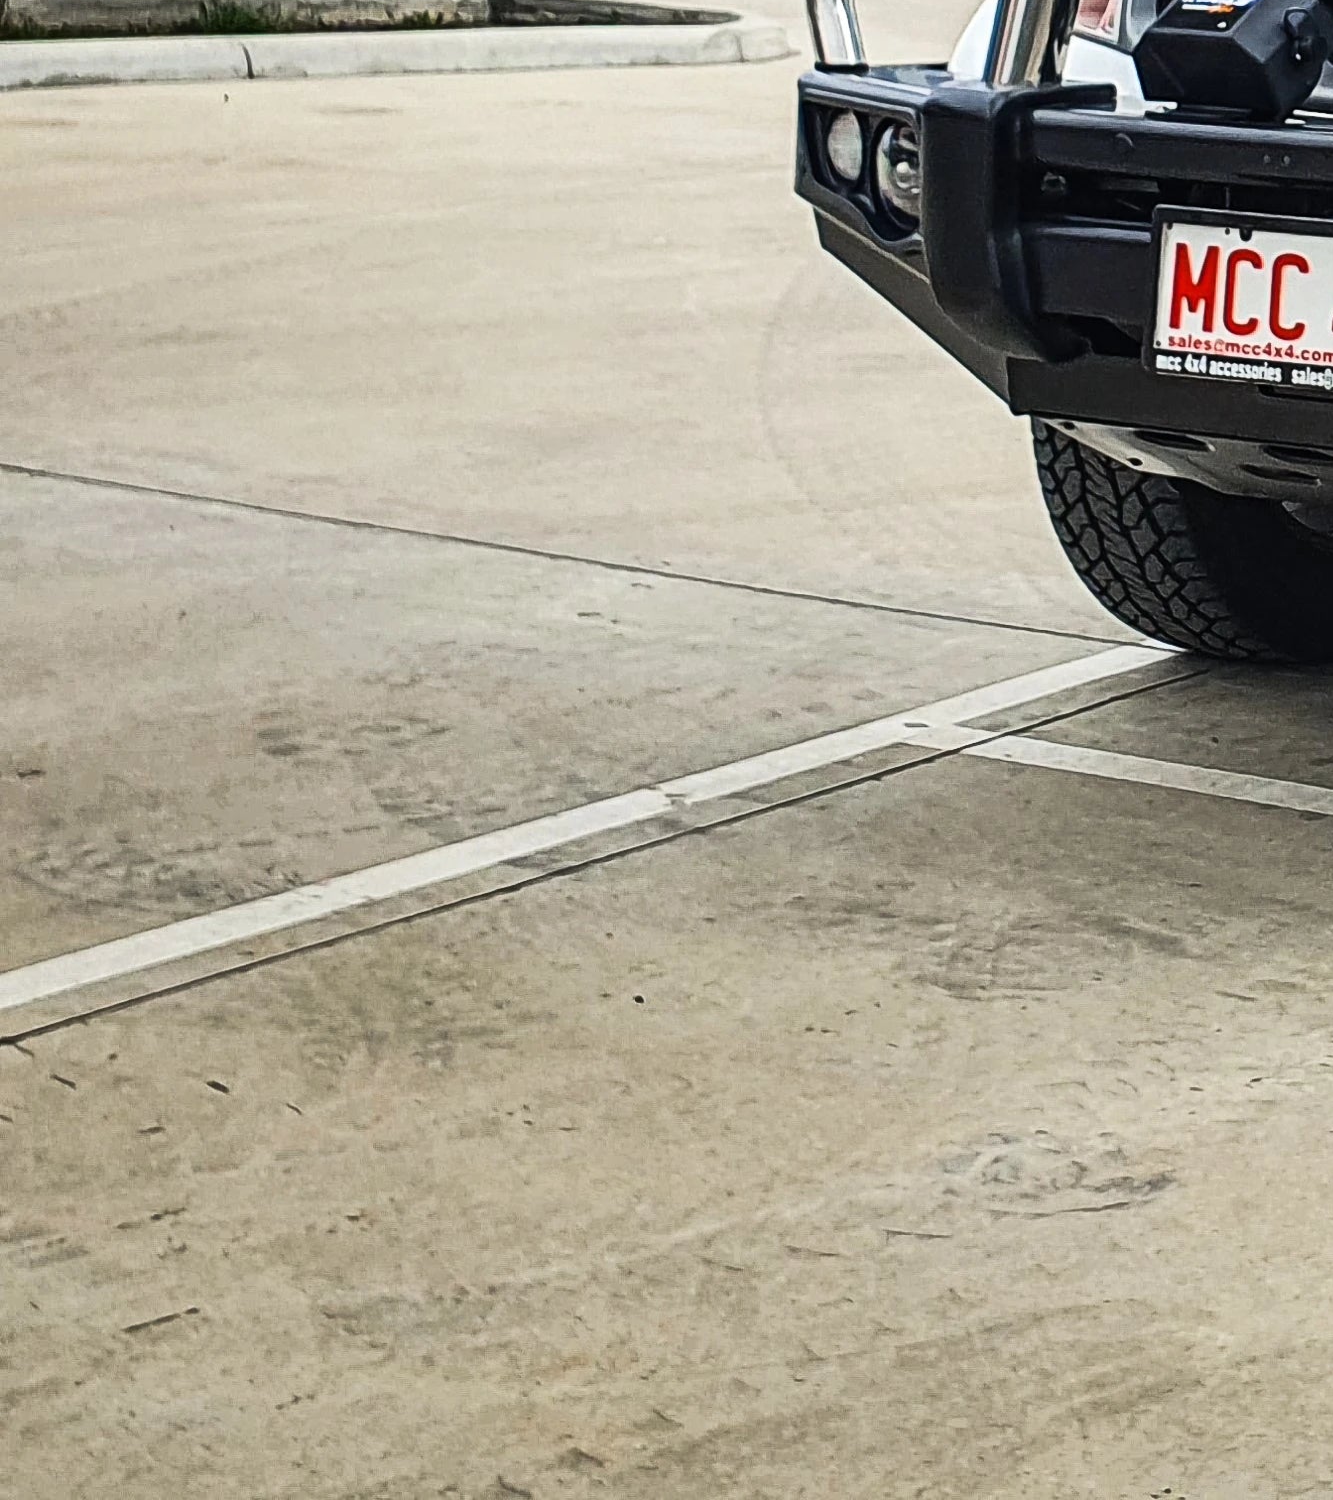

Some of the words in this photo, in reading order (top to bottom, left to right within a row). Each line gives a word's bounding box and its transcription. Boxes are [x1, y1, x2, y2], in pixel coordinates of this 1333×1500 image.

[1168, 242, 1310, 341] MCC
[1155, 354, 1182, 372] mcc
[1184, 353, 1207, 374] 4x4
[1209, 361, 1282, 383] accessories
